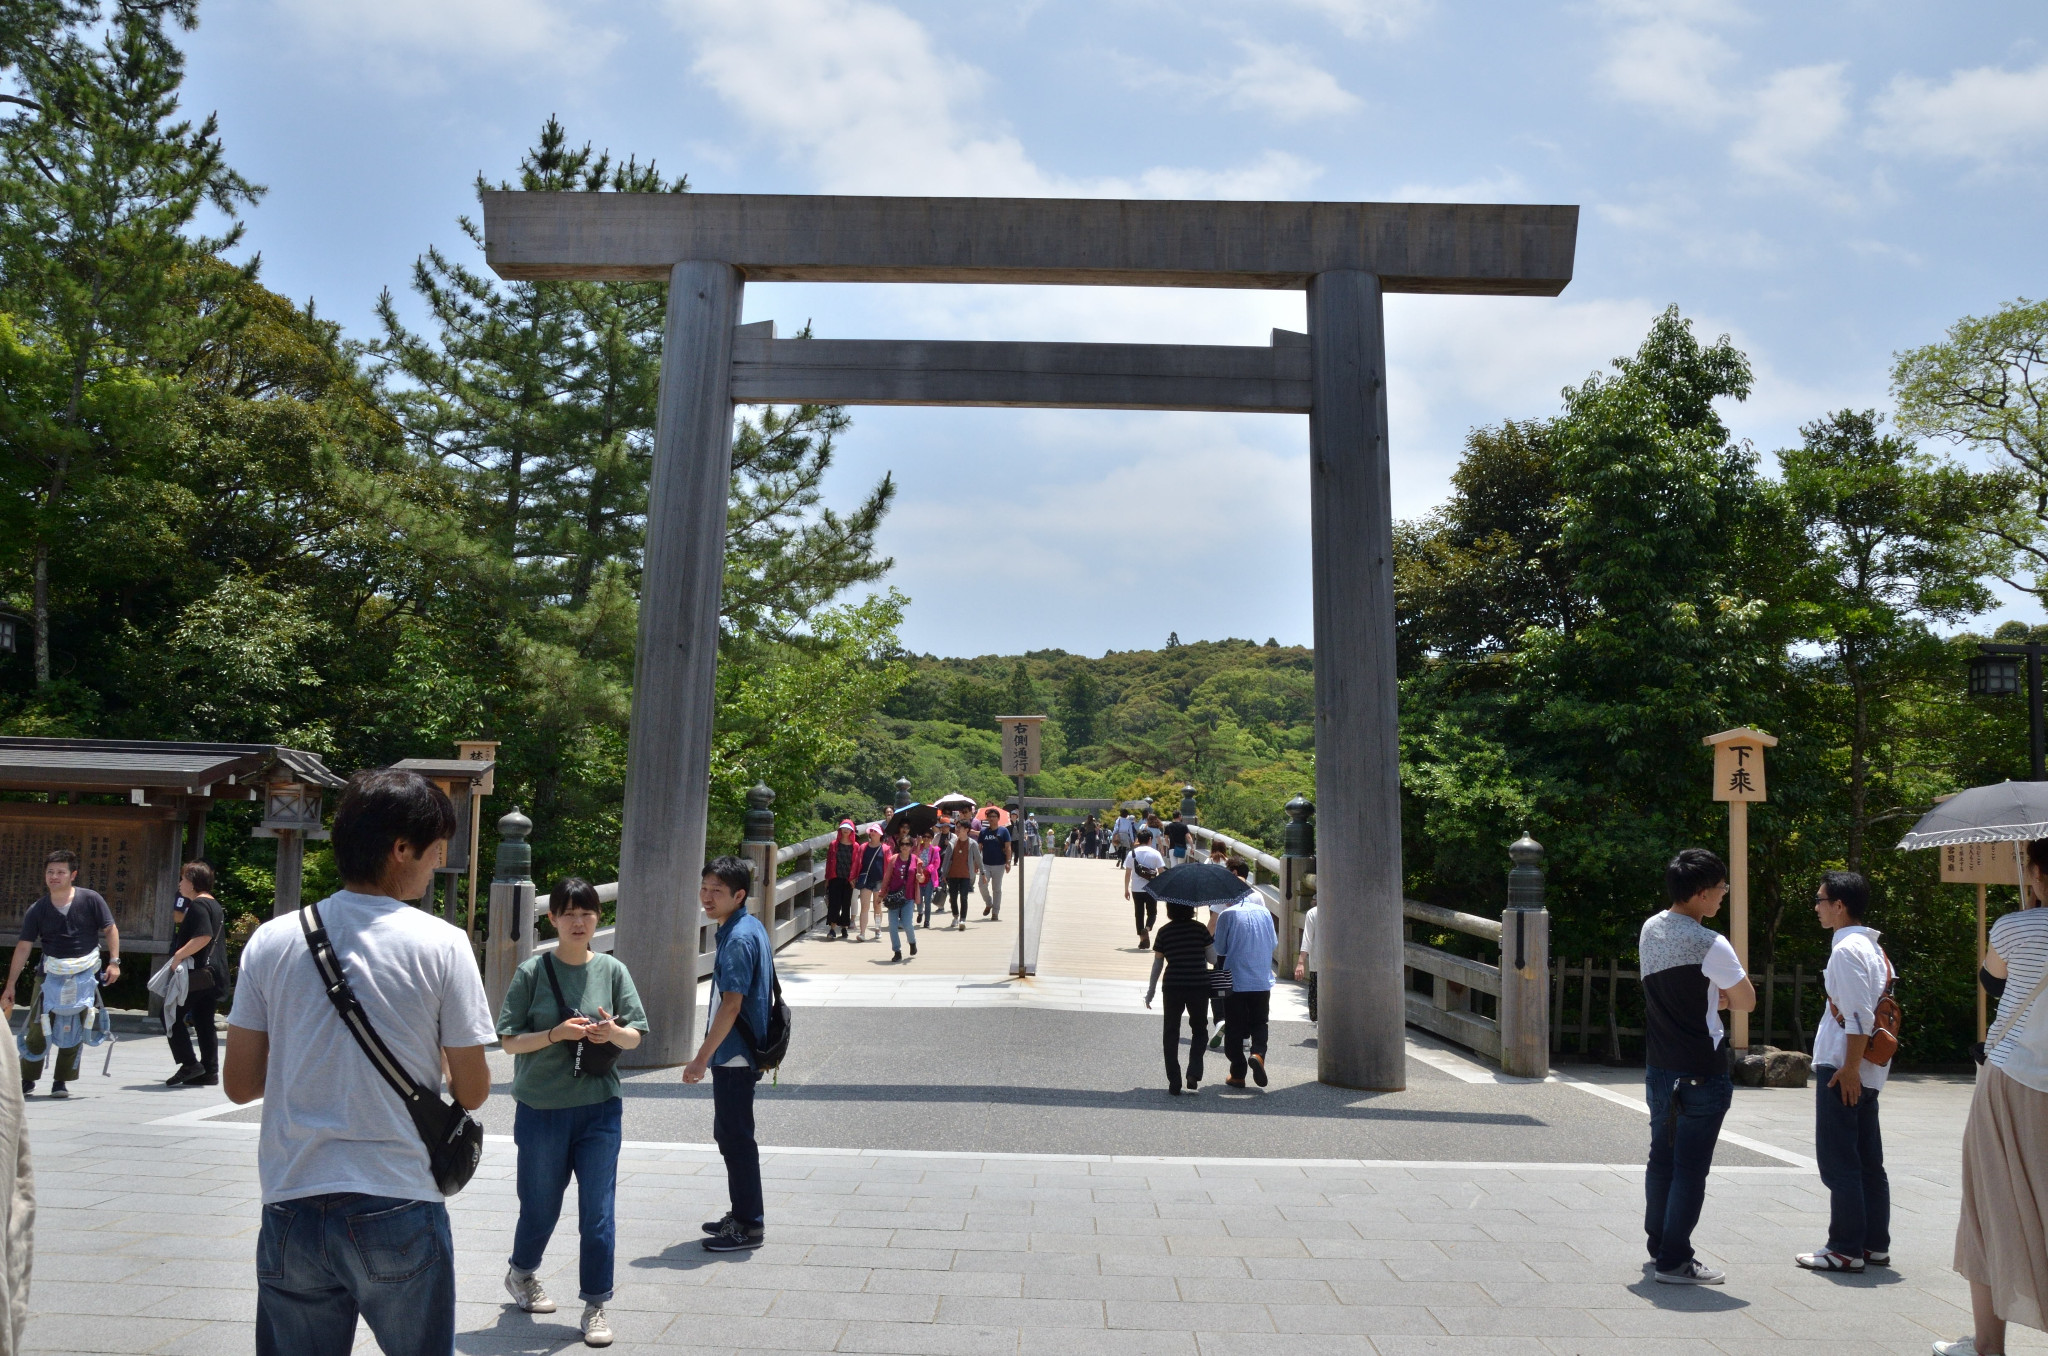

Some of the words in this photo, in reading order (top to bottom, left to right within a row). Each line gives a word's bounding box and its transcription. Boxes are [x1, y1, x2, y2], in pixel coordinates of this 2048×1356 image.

[1014, 722, 1028, 772] 右側通行
[576, 1042, 584, 1056] niko
